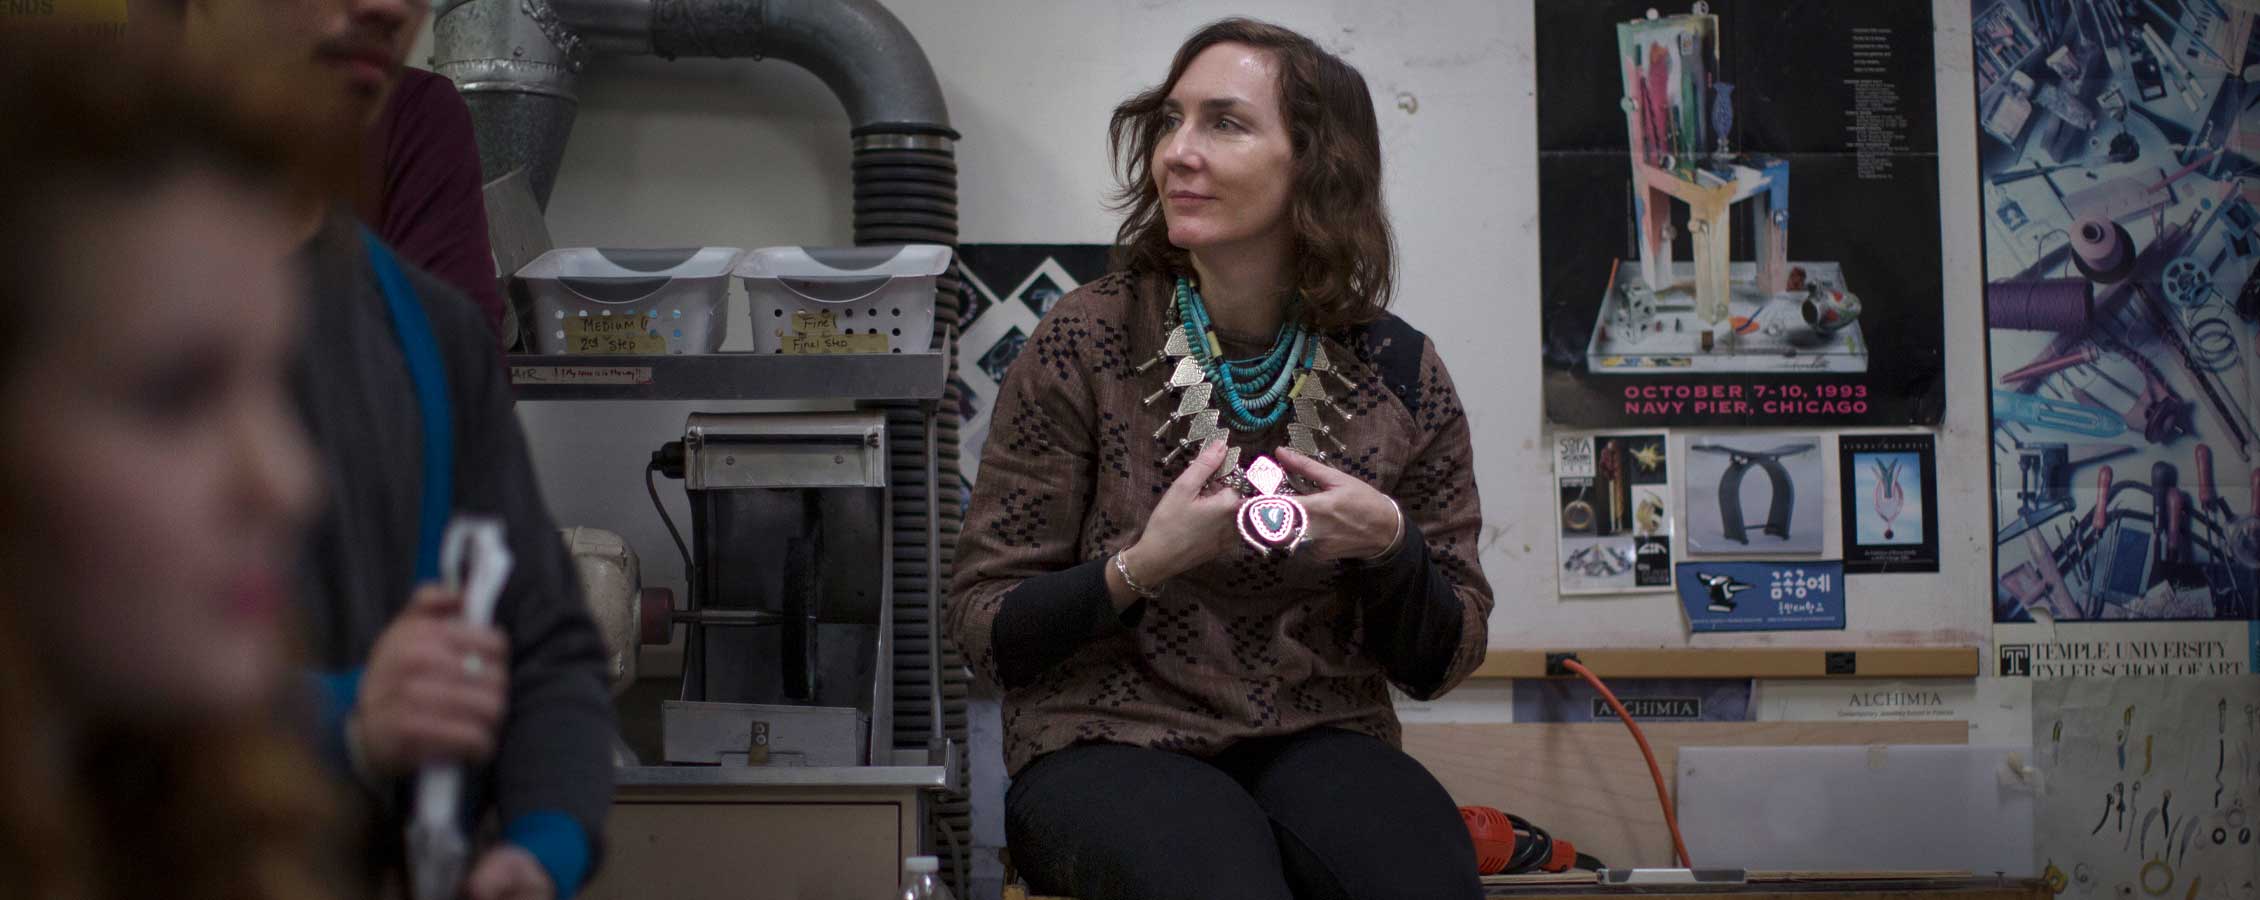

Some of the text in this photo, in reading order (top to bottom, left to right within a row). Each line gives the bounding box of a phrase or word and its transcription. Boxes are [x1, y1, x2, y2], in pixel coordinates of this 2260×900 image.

[583, 318, 635, 333] MEDIUM
[1625, 384, 1868, 400] OCTOBER 7-10, 1993
[1625, 400, 1869, 416] NAVY PIER, CHICAGO
[1771, 568, 1831, 601] 금속공예
[2033, 641, 2225, 660] TEMPLE UNIVERSITY
[1848, 691, 1943, 707] ALCHIMIA
[1597, 701, 1695, 716] ACHIMIA
